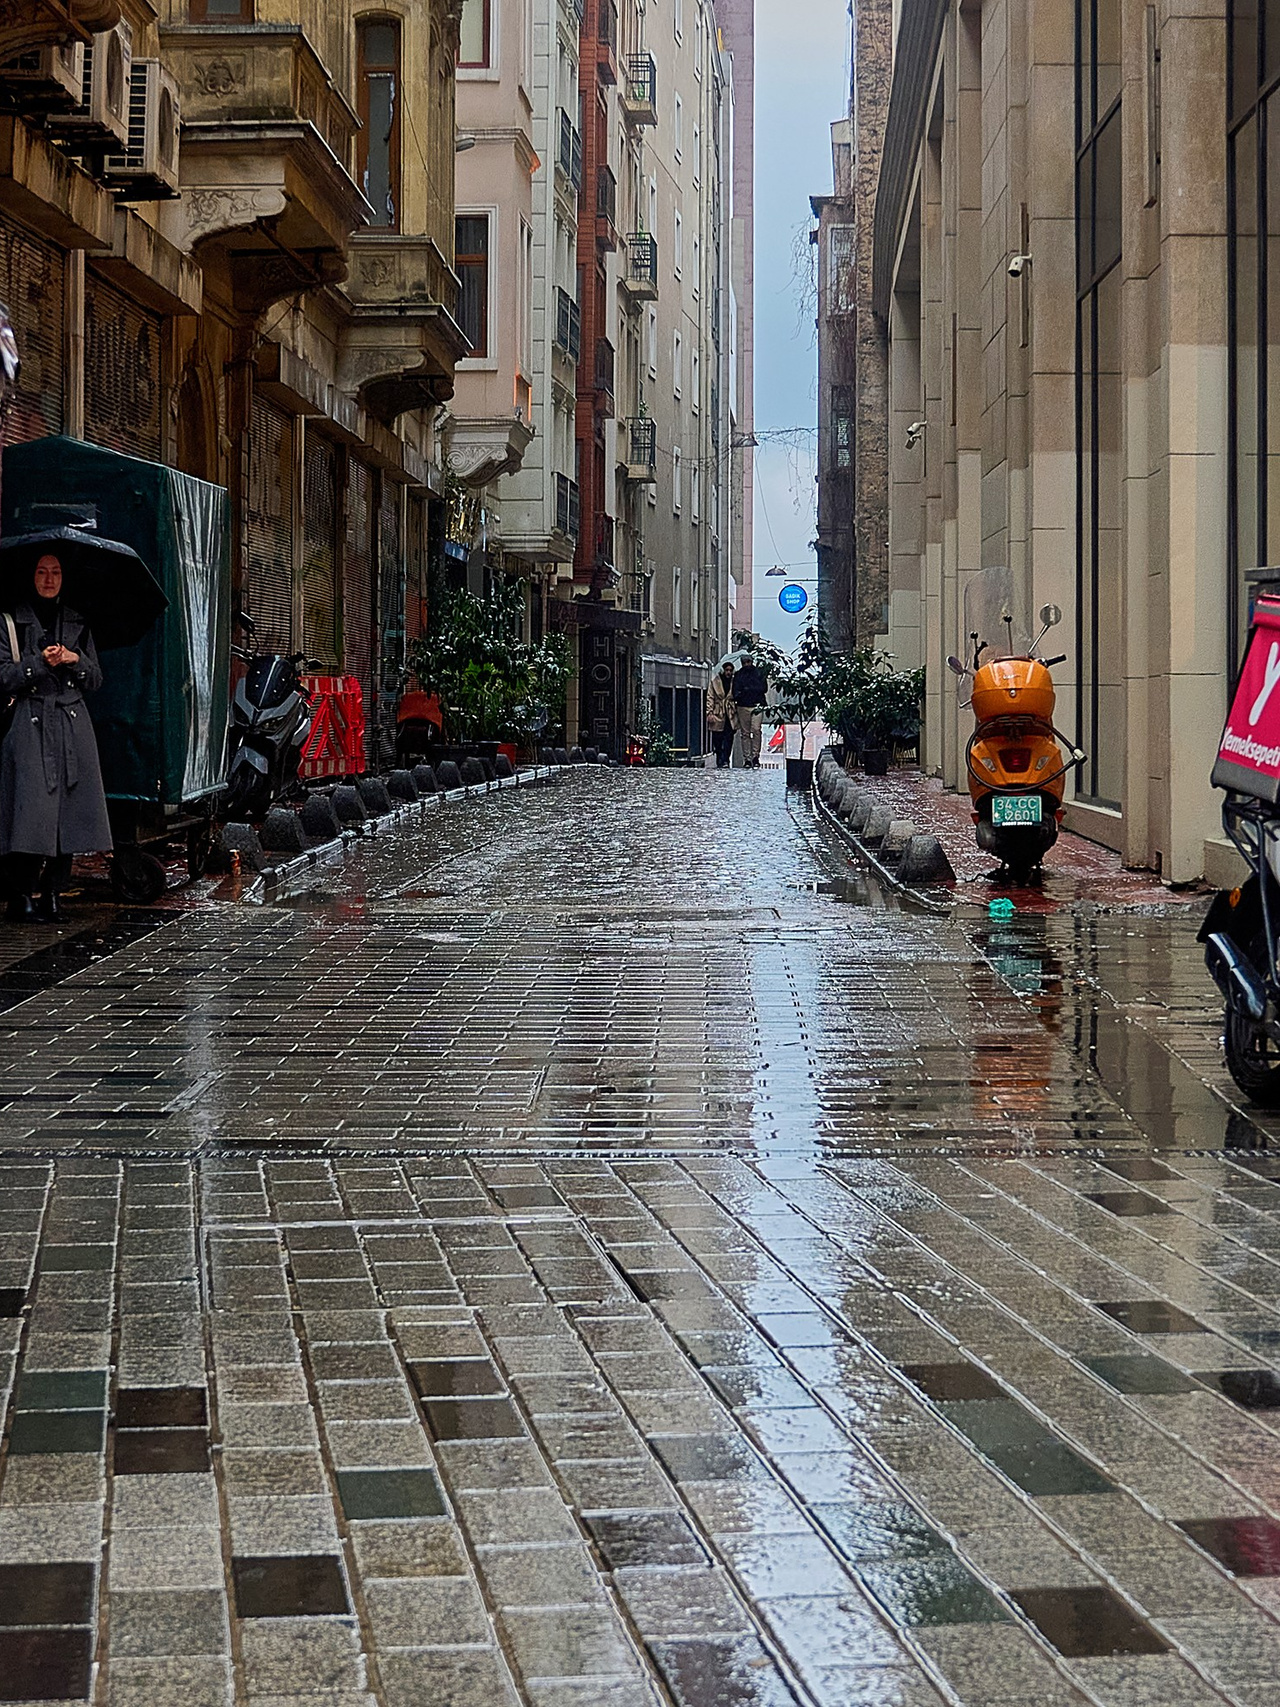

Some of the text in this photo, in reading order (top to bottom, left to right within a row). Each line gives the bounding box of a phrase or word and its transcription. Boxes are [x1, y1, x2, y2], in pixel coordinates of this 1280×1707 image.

[996, 798, 1037, 810] 34 CC
[1005, 810, 1036, 821] 2601
